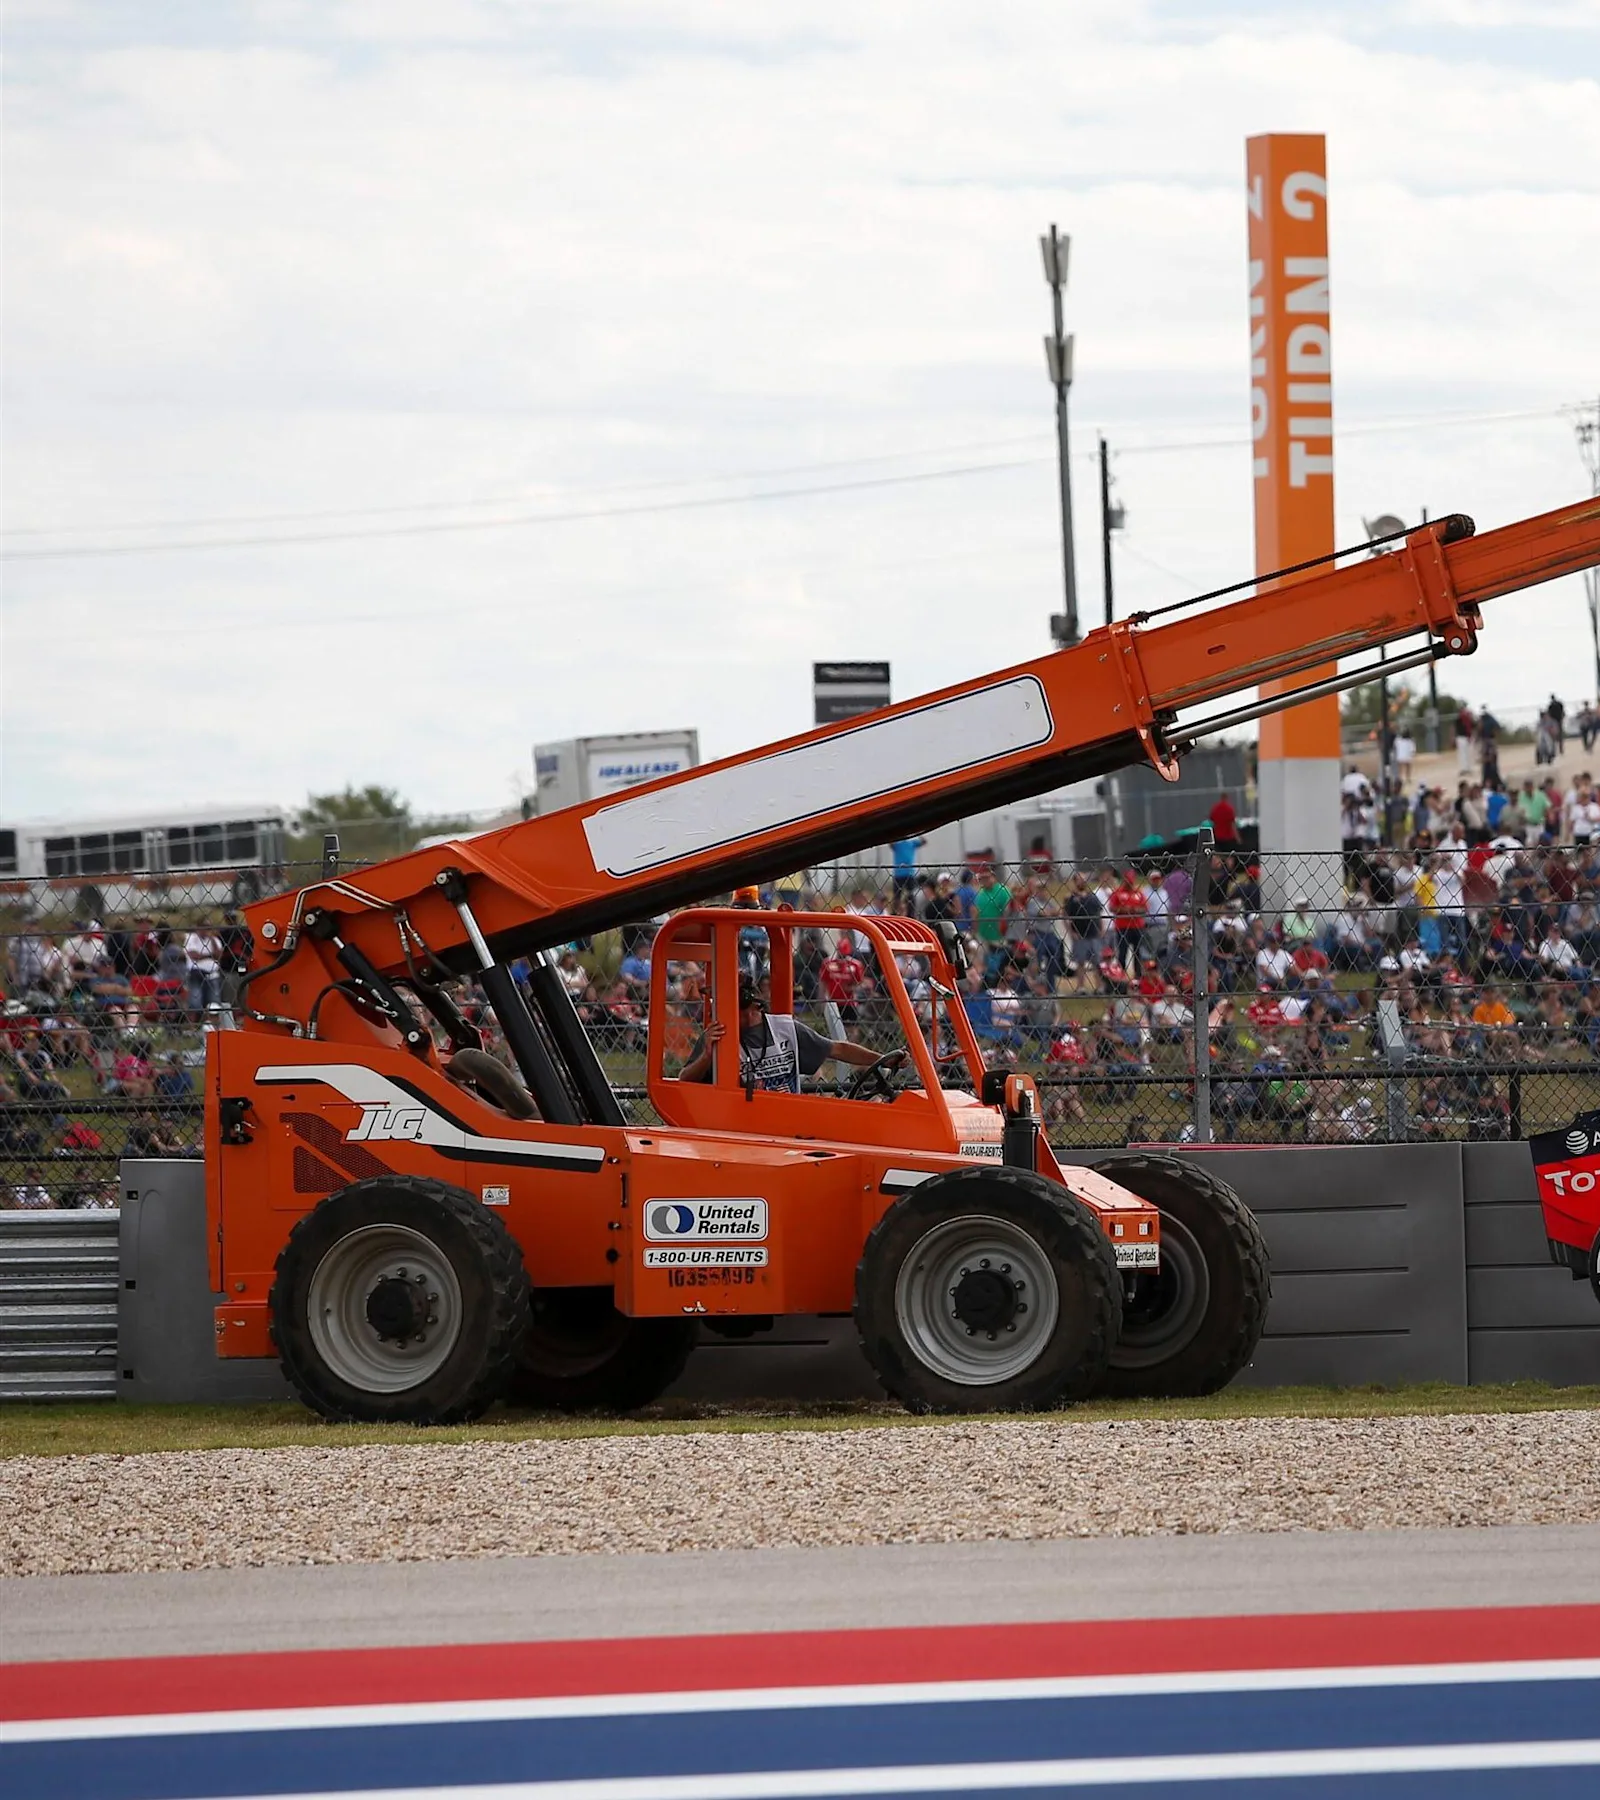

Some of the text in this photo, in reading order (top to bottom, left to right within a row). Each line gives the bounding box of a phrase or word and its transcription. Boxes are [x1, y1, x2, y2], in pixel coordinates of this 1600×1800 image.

[598, 761, 680, 777] IDEALEASE
[345, 1109, 426, 1141] JLG
[698, 1205, 755, 1219] United
[697, 1220, 760, 1234] Rentals
[648, 1251, 764, 1263] 1-800-UR-RENTS
[1135, 1248, 1156, 1262] Rentals
